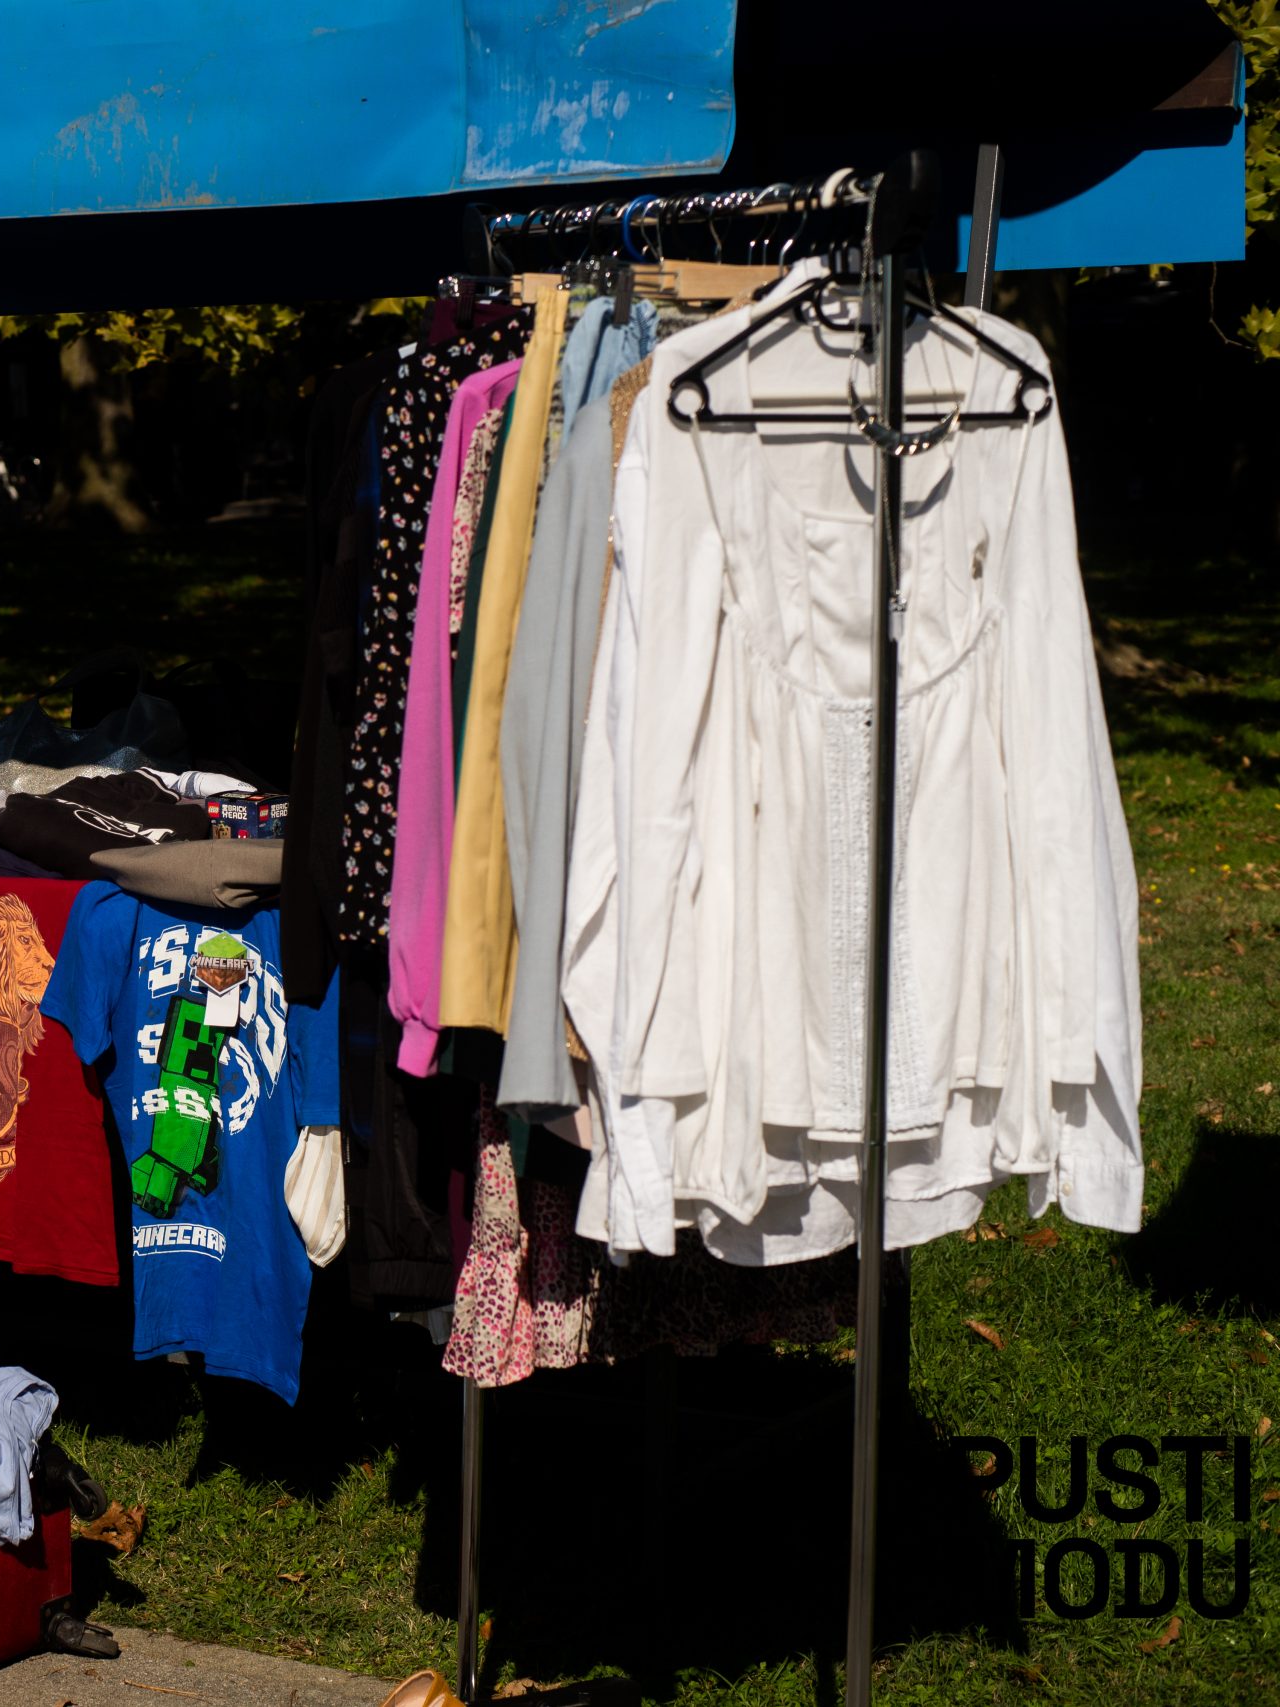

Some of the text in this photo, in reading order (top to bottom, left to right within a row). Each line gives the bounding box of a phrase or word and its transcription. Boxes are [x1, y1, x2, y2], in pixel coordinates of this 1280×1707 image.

[227, 804, 247, 813] BRICK
[222, 811, 248, 820] HEADZ
[190, 955, 255, 970] MINECRAFT
